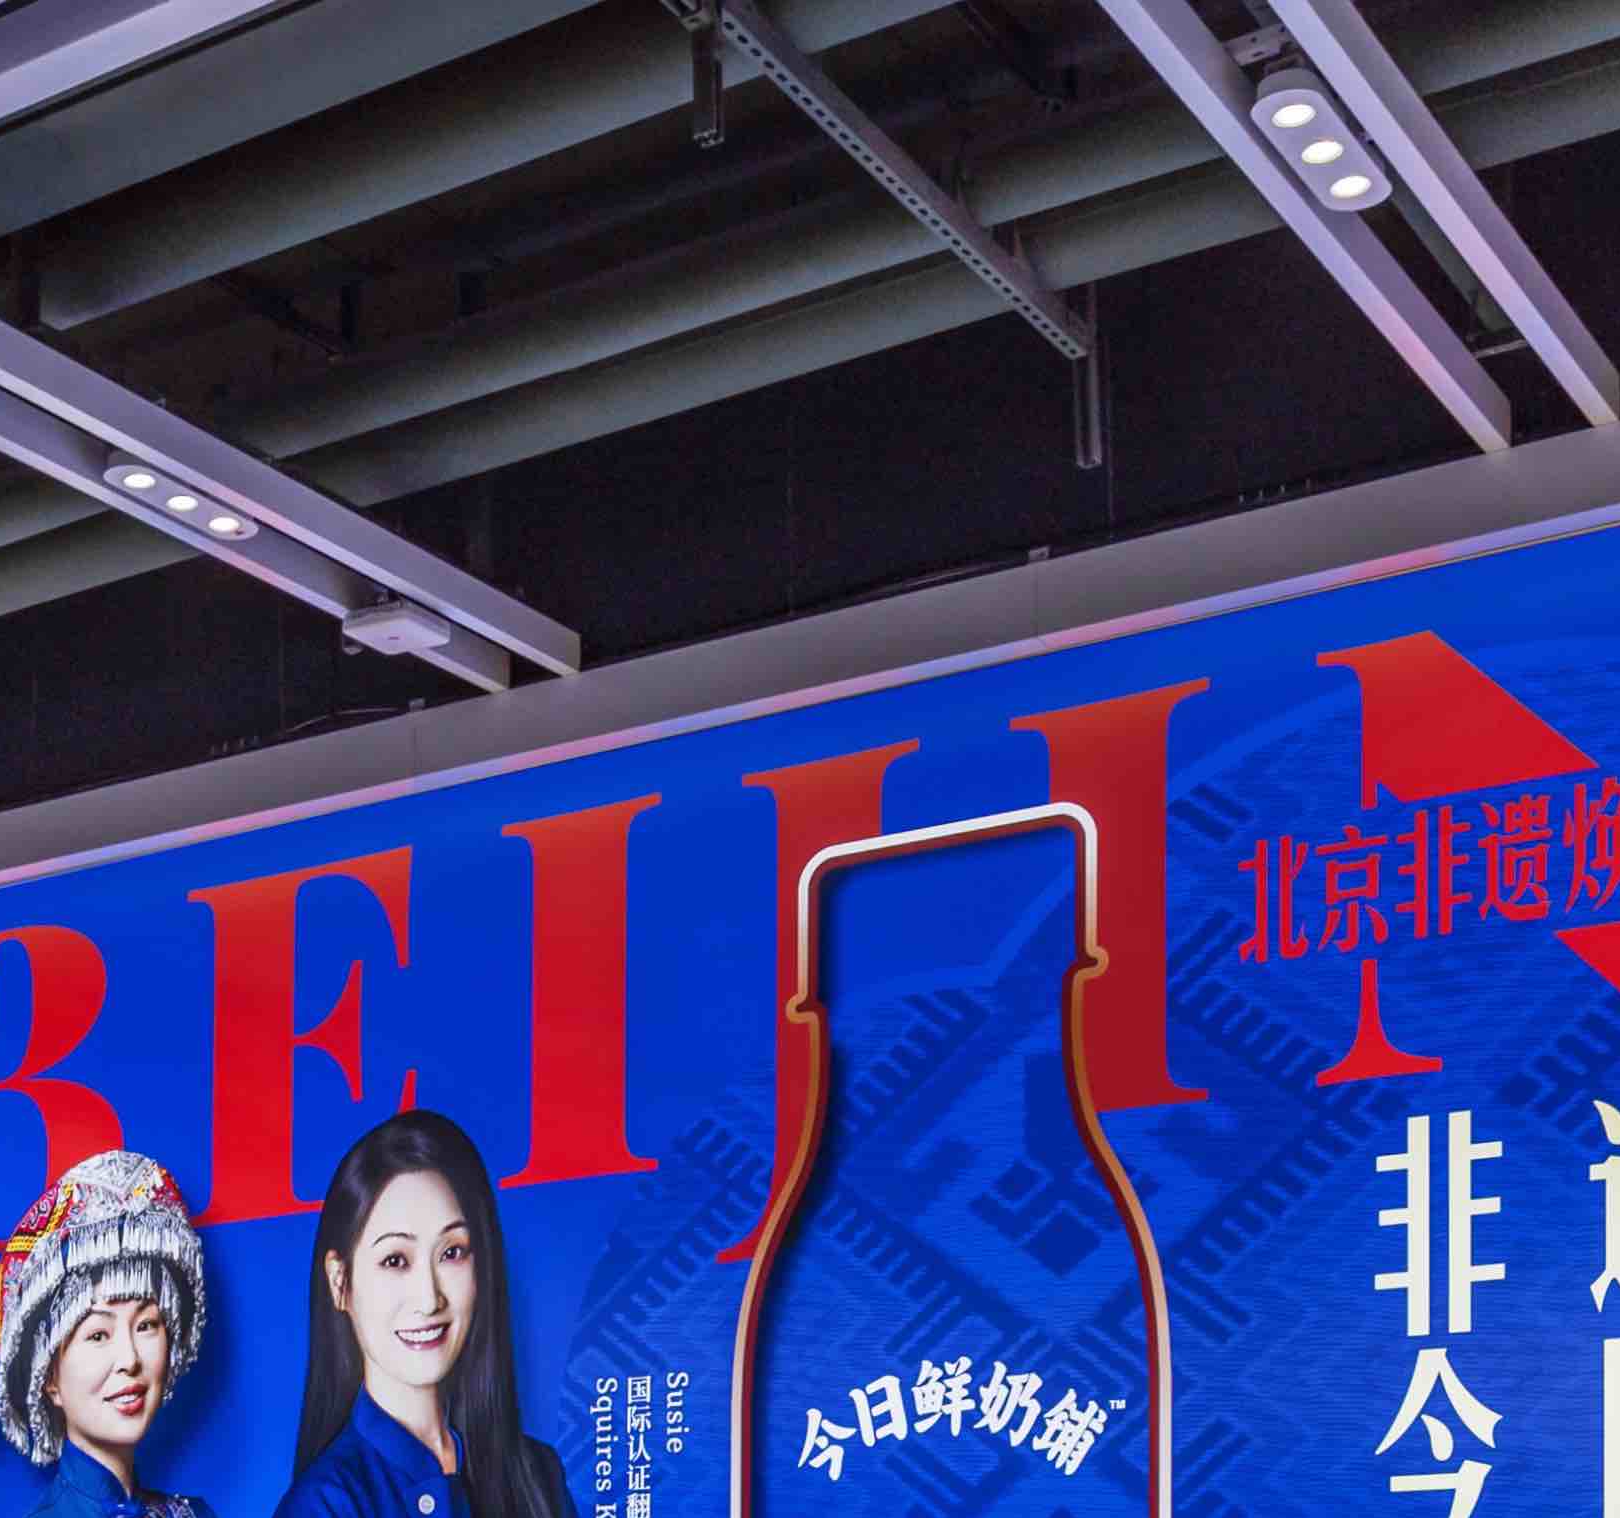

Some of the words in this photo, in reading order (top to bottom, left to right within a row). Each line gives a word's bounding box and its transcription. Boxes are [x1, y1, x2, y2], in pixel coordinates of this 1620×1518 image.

[590, 1377, 619, 1492] Squires
[666, 1371, 690, 1453] Susie
[797, 1355, 1108, 1481] 今日鲜奶铺
